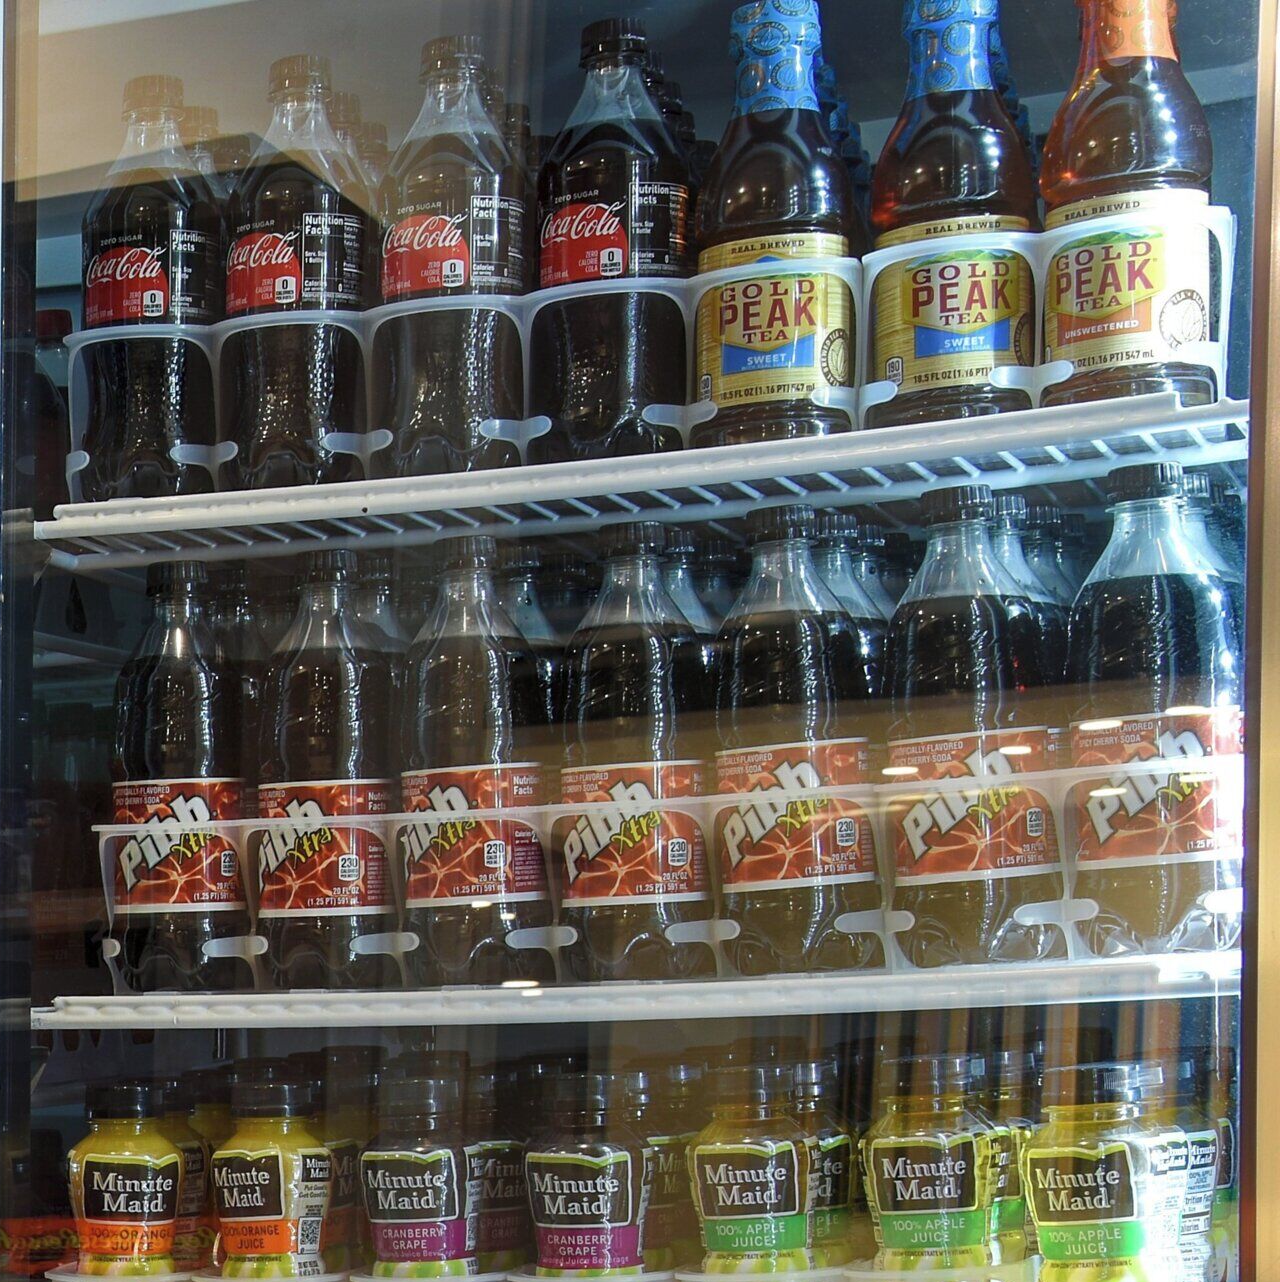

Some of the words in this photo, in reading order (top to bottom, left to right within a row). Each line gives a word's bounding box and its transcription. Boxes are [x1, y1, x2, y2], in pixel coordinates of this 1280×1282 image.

[305, 215, 343, 226] Nutrition
[925, 224, 954, 235] REAL
[957, 220, 1001, 232] BREWED
[305, 225, 330, 235] Facts
[731, 244, 757, 255] REAL
[760, 239, 805, 251] BREWED
[608, 251, 614, 261] 0
[1056, 240, 1152, 272] GOLD
[86, 243, 167, 288] Coca-Cola
[912, 261, 1010, 285] GOLD
[1056, 257, 1154, 306] PEAK
[720, 280, 816, 303] GOLD
[912, 278, 1011, 318] PEAK
[1077, 295, 1121, 312] TEA
[719, 296, 818, 336] PEAK
[940, 311, 988, 326] TEA
[1065, 318, 1139, 339] UNSWEETENED
[743, 328, 788, 344] TEA
[944, 335, 985, 348] SWEET
[747, 353, 786, 365] SWEET
[913, 373, 929, 383] 18.5
[931, 372, 939, 382] FL
[1094, 736, 1119, 746] CHERRY
[1121, 734, 1141, 743] SODA
[741, 753, 772, 763] FLAVORED
[576, 772, 608, 782] FLAVORED
[669, 841, 686, 854] 230
[341, 857, 358, 869] 230
[703, 1164, 786, 1183] Minute
[92, 1172, 173, 1193] Minute
[534, 1173, 619, 1194] Minute
[102, 1193, 165, 1213] Maid
[377, 1191, 436, 1210] Maid
[544, 1195, 607, 1215] Maid
[382, 1228, 442, 1238] CRANBERRY
[716, 1226, 742, 1236] 100%
[746, 1222, 785, 1235] APPLE
[1049, 1232, 1077, 1242] 100%
[1079, 1228, 1122, 1241] APPLE
[393, 1240, 427, 1250] GRAPE
[548, 1234, 613, 1245] CRANBERRY
[732, 1236, 770, 1247] JUICE
[559, 1246, 597, 1256] GRAPE
[1065, 1243, 1106, 1255] JUICE
